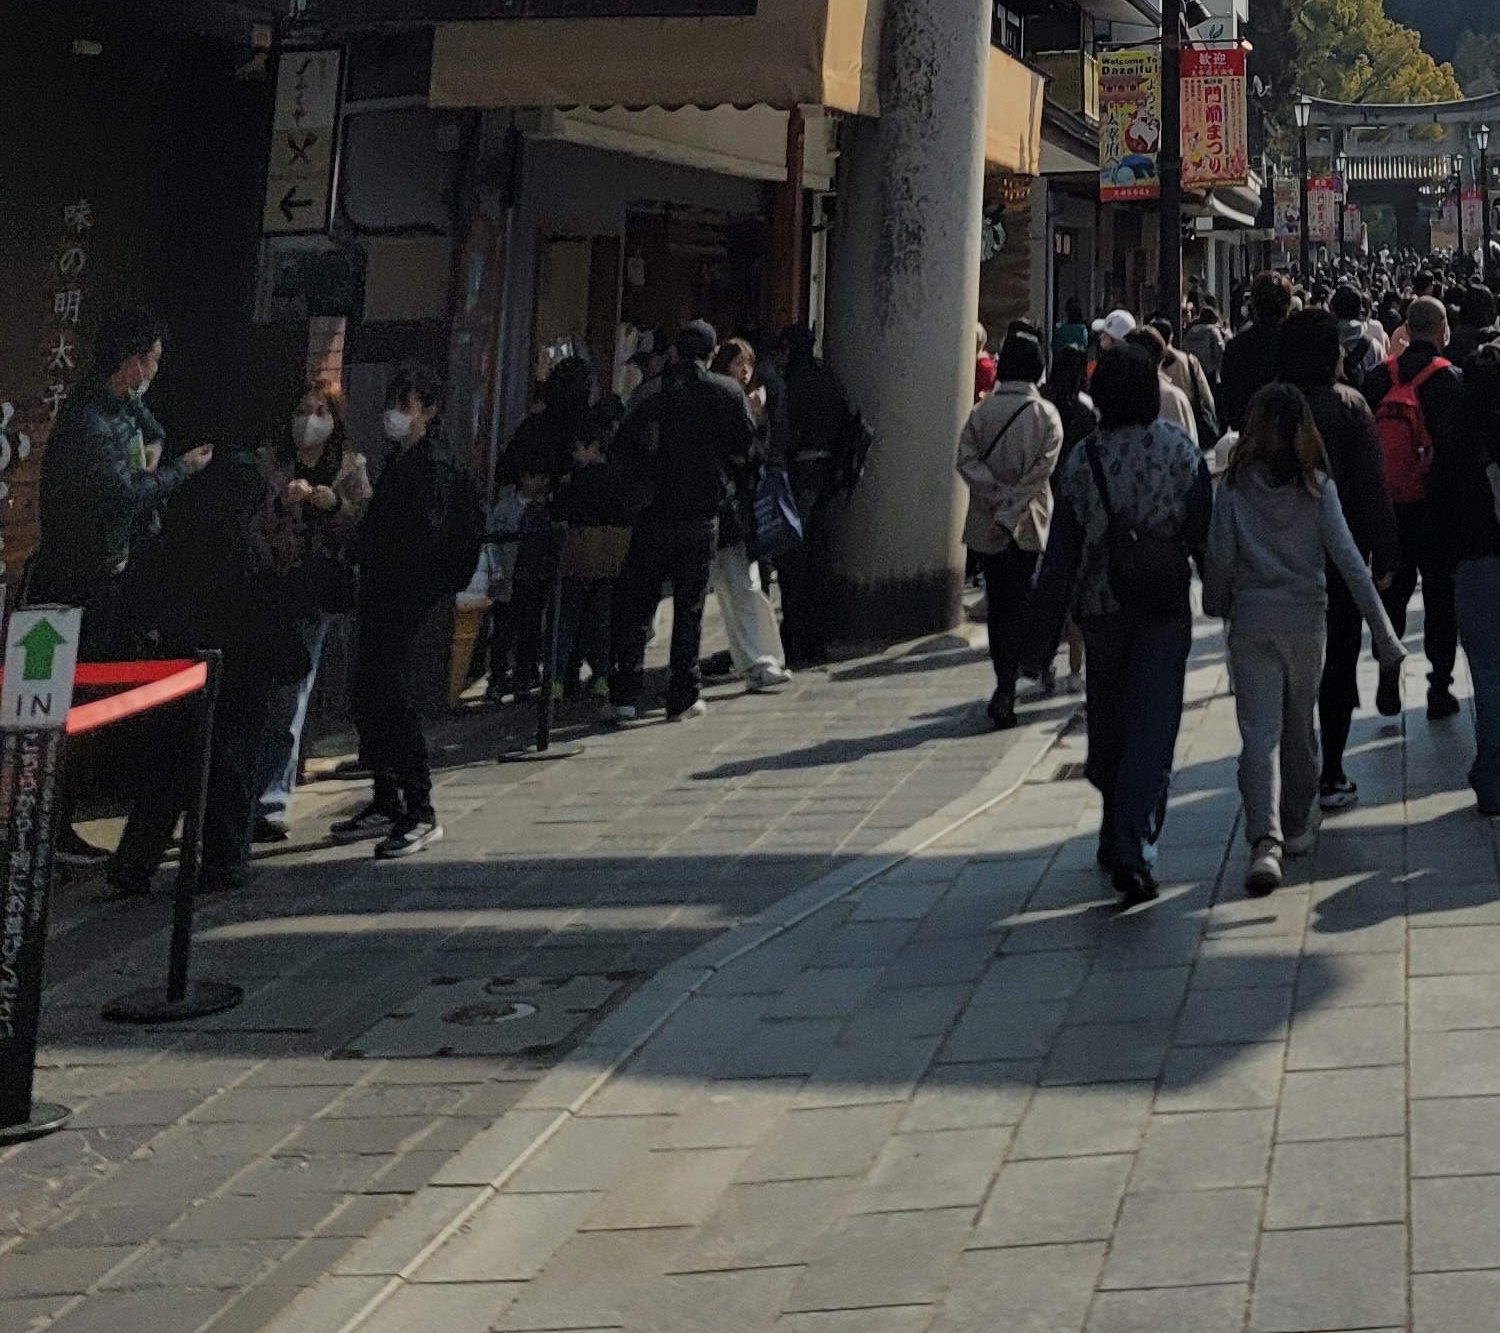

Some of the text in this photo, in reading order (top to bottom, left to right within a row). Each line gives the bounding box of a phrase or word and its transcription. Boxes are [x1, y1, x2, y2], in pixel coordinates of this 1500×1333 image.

[1147, 55, 1158, 63] To
[1204, 84, 1223, 174] 門前まつり
[44, 197, 94, 419] 味の明太子
[16, 693, 51, 717] IN
